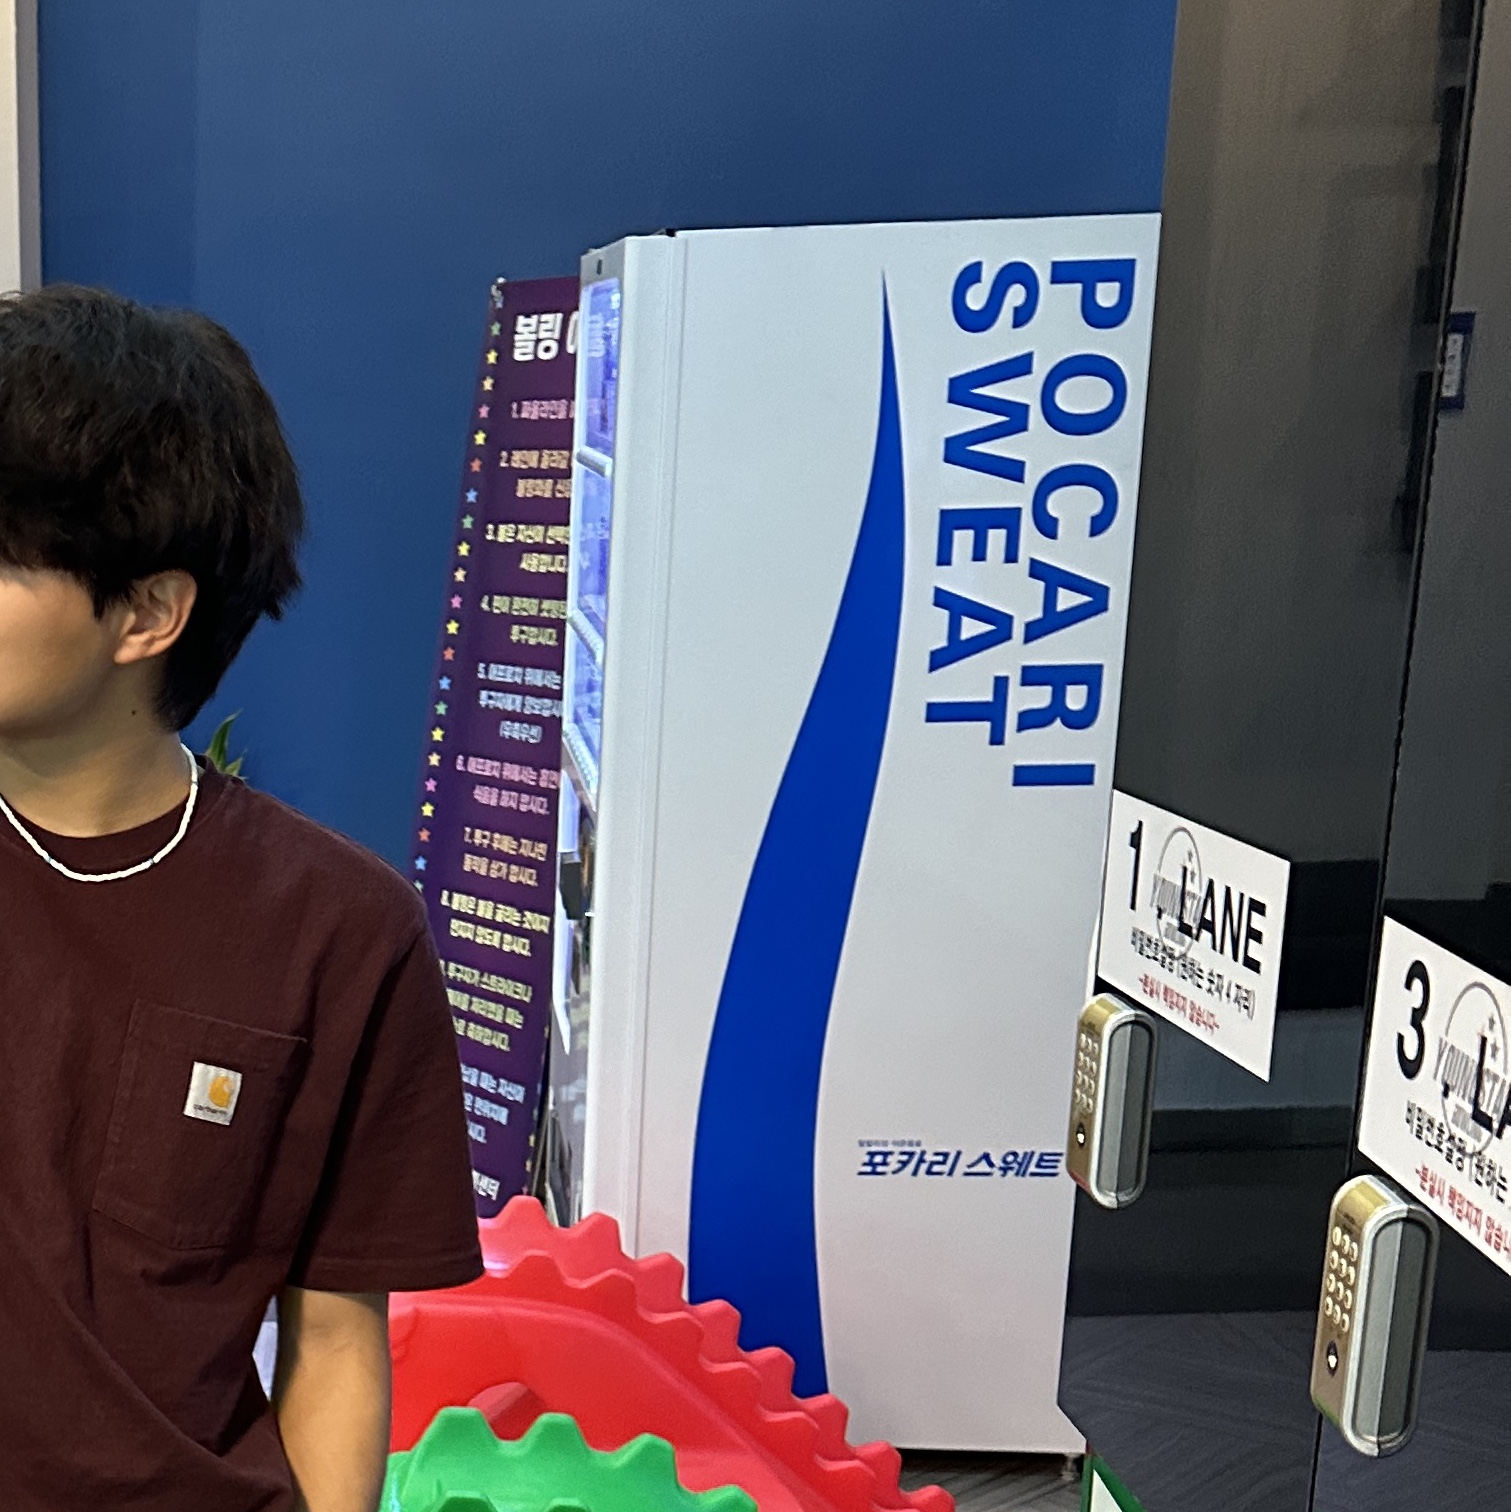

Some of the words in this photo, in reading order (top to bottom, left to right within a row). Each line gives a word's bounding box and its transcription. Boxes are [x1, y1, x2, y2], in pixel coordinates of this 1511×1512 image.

[512, 311, 562, 362] 볼링
[924, 259, 1040, 747] SWEAT
[1011, 257, 1137, 788] POCARI
[1129, 819, 1143, 912] 1
[1177, 864, 1268, 976] LANE
[1396, 959, 1431, 1081] 3
[857, 1149, 962, 1178] 포카리
[962, 1149, 1064, 1178] 스웨트
